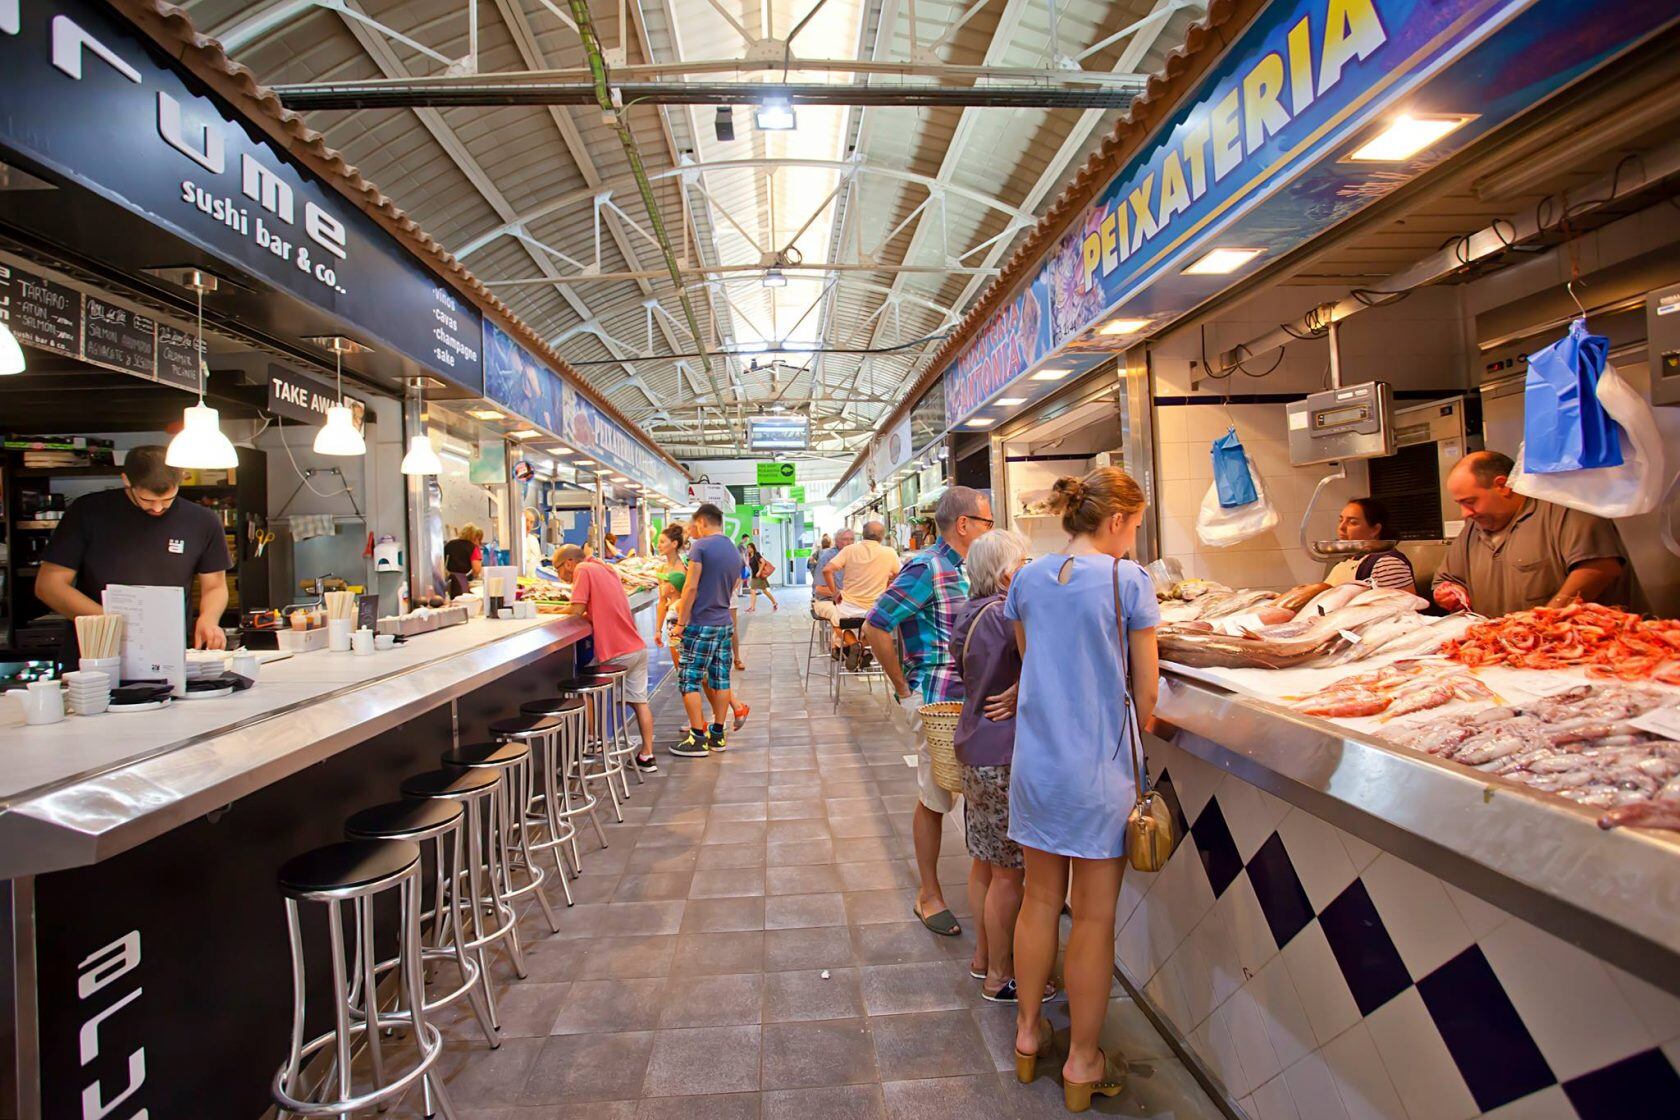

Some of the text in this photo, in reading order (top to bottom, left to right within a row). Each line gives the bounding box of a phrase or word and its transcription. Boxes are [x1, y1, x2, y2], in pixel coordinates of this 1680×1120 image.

[0, 0, 347, 259] rume
[1083, 0, 1387, 293] PEIXATERIA
[183, 181, 248, 235] sushi
[256, 218, 292, 260] bar
[297, 247, 312, 273] &
[273, 378, 308, 408] TAKE
